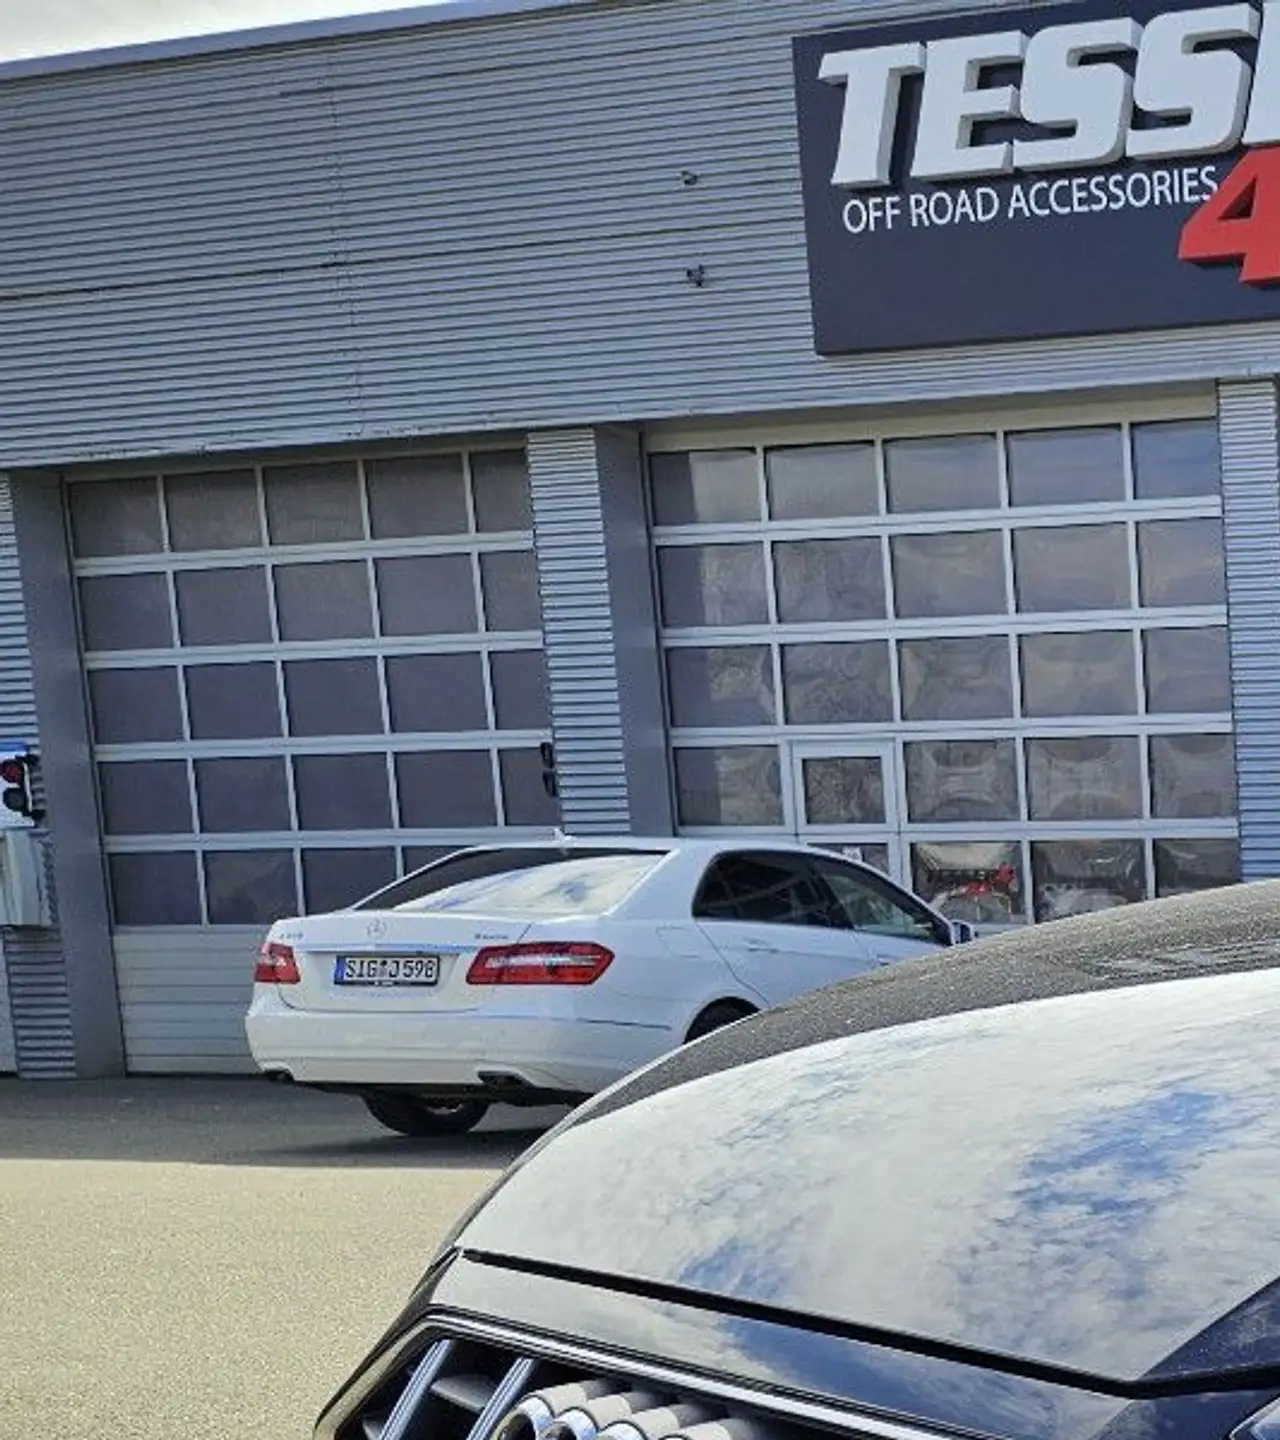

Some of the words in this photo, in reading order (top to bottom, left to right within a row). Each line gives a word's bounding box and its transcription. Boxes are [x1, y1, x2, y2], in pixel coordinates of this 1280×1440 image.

[843, 195, 901, 234] OFF
[909, 186, 1000, 227] ROAD
[1007, 165, 1220, 219] ACCESSORIES
